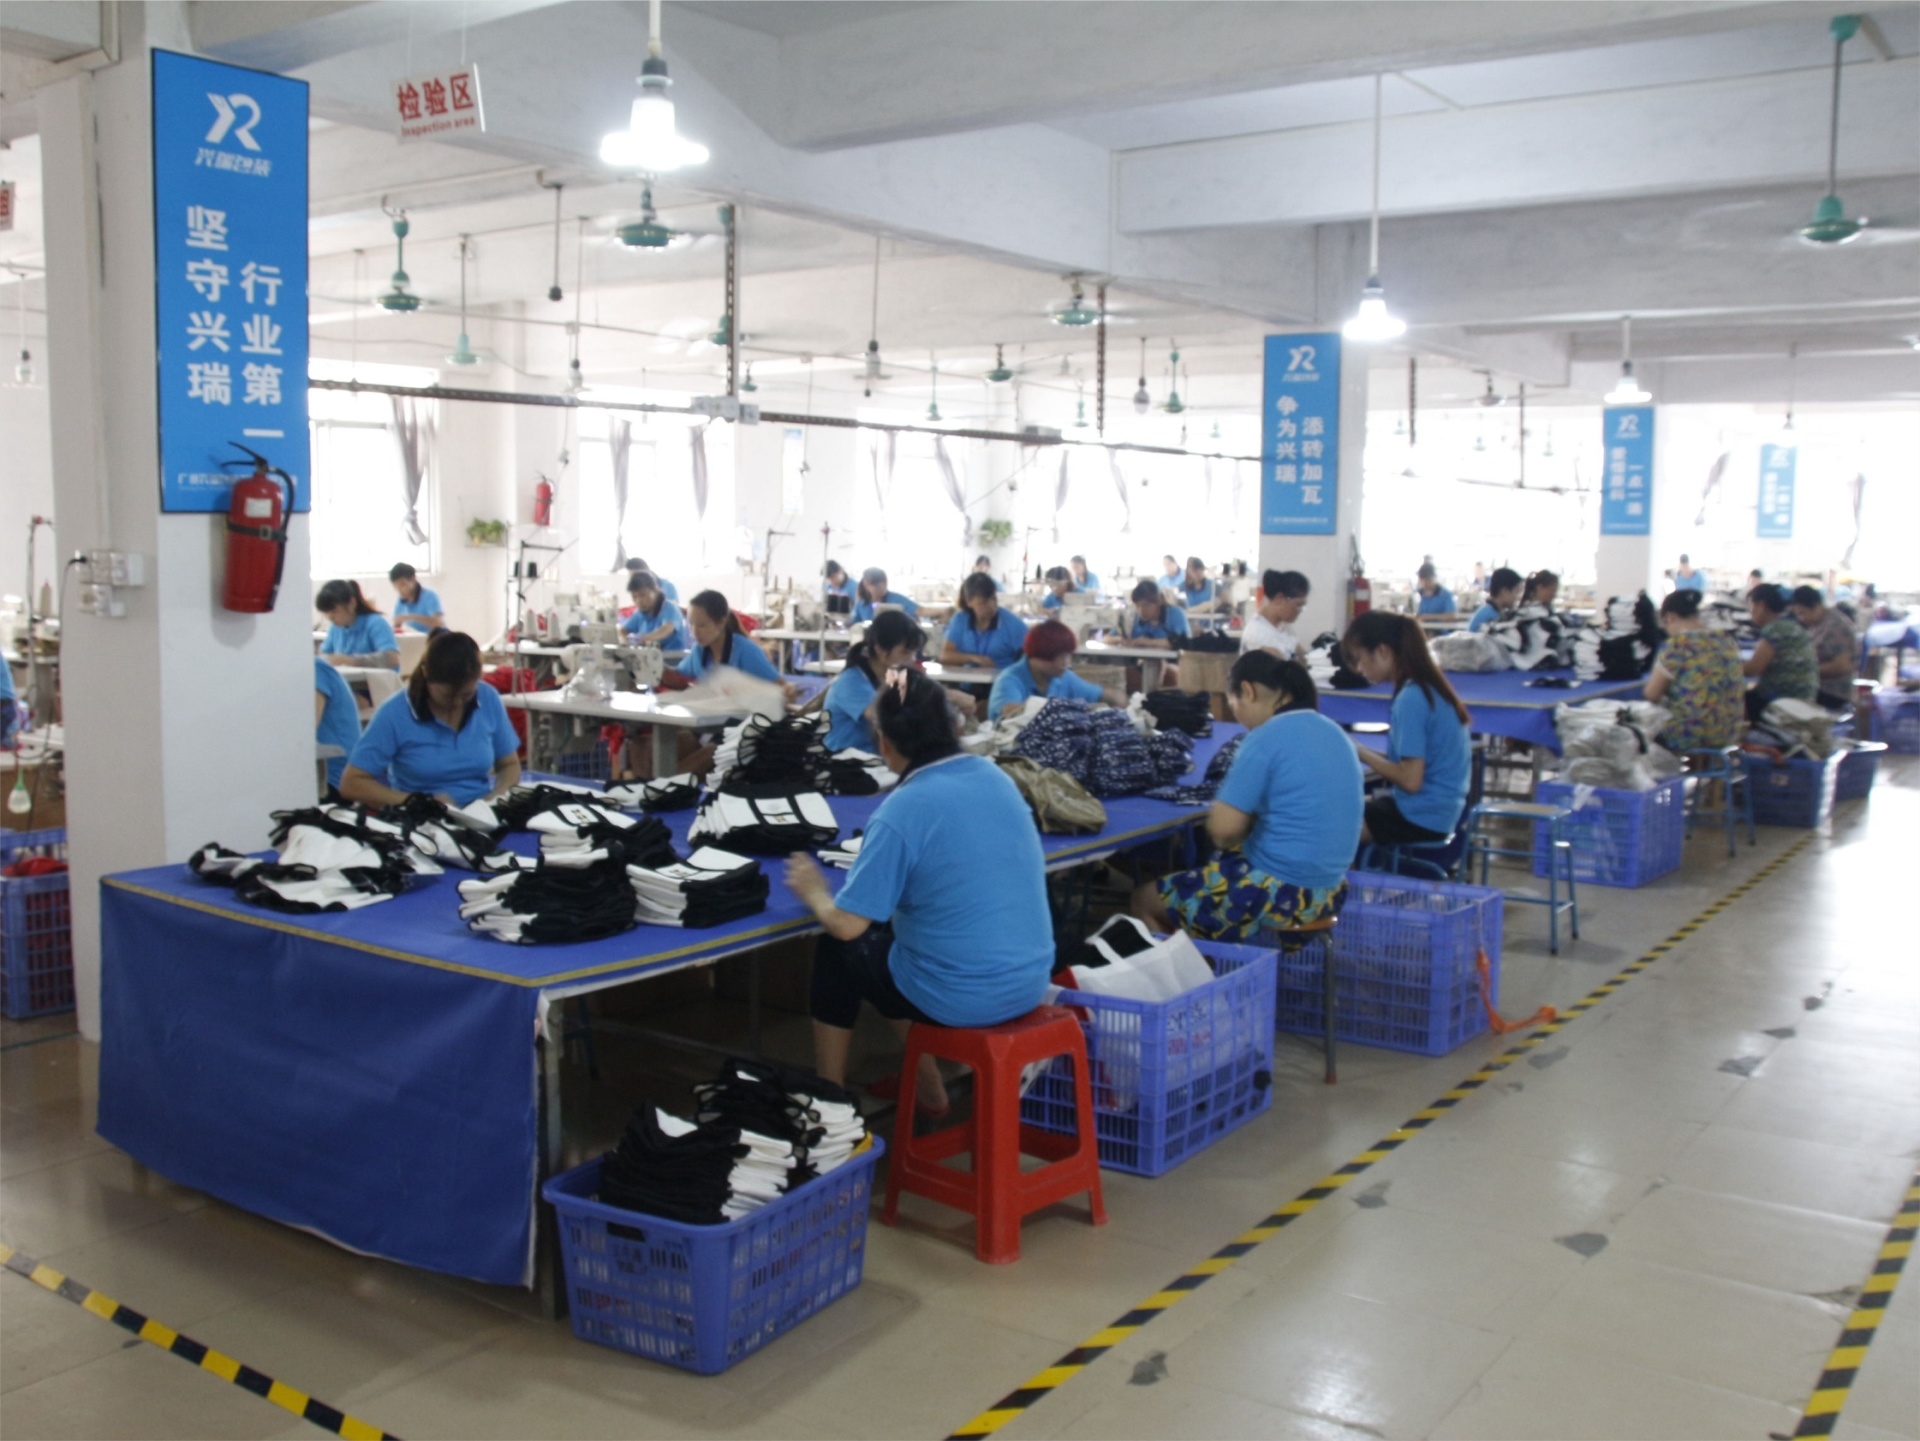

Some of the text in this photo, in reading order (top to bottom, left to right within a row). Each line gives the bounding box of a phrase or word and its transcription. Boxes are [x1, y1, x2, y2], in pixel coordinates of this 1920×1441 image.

[397, 73, 475, 121] 检验区
[401, 116, 475, 137] Inspection area
[186, 205, 232, 406] 坚守兴瑞
[240, 261, 285, 438] 行业第一
[1275, 395, 1298, 484] 争为兴瑞
[1301, 416, 1325, 505] 添砖加瓦
